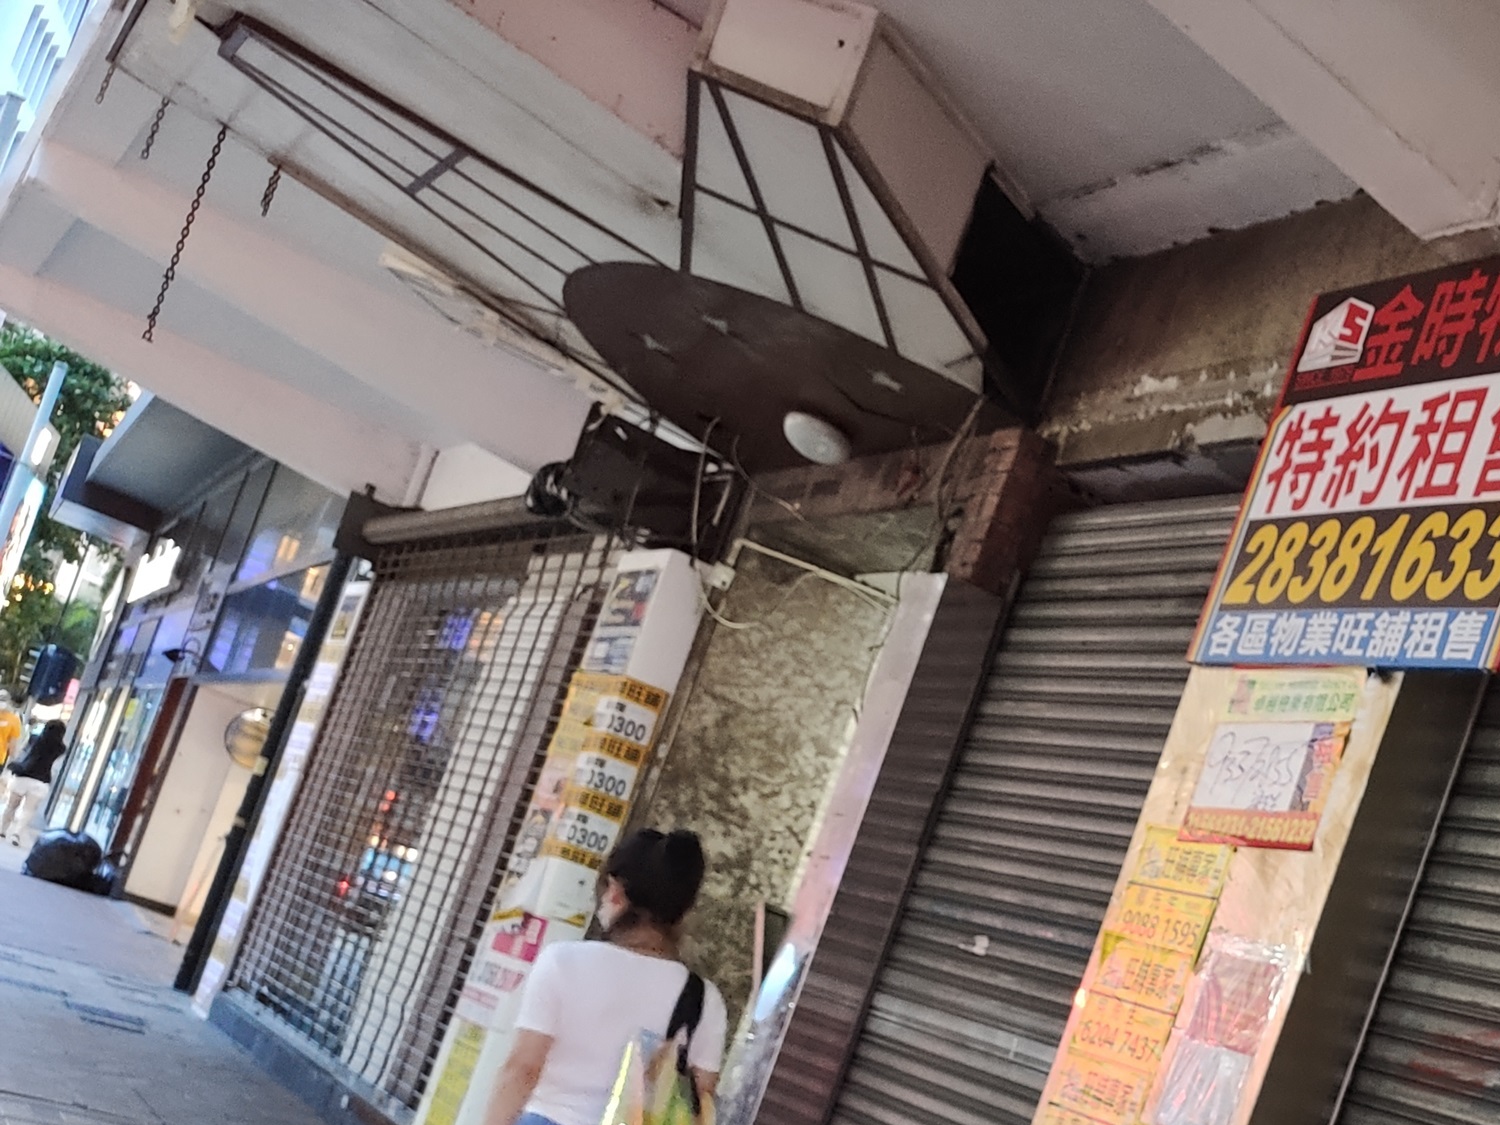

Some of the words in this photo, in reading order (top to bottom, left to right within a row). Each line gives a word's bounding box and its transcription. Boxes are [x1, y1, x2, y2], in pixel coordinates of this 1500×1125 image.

[1207, 610, 1489, 662] 各區物業旺舖租售
[1163, 916, 1201, 949] 1595
